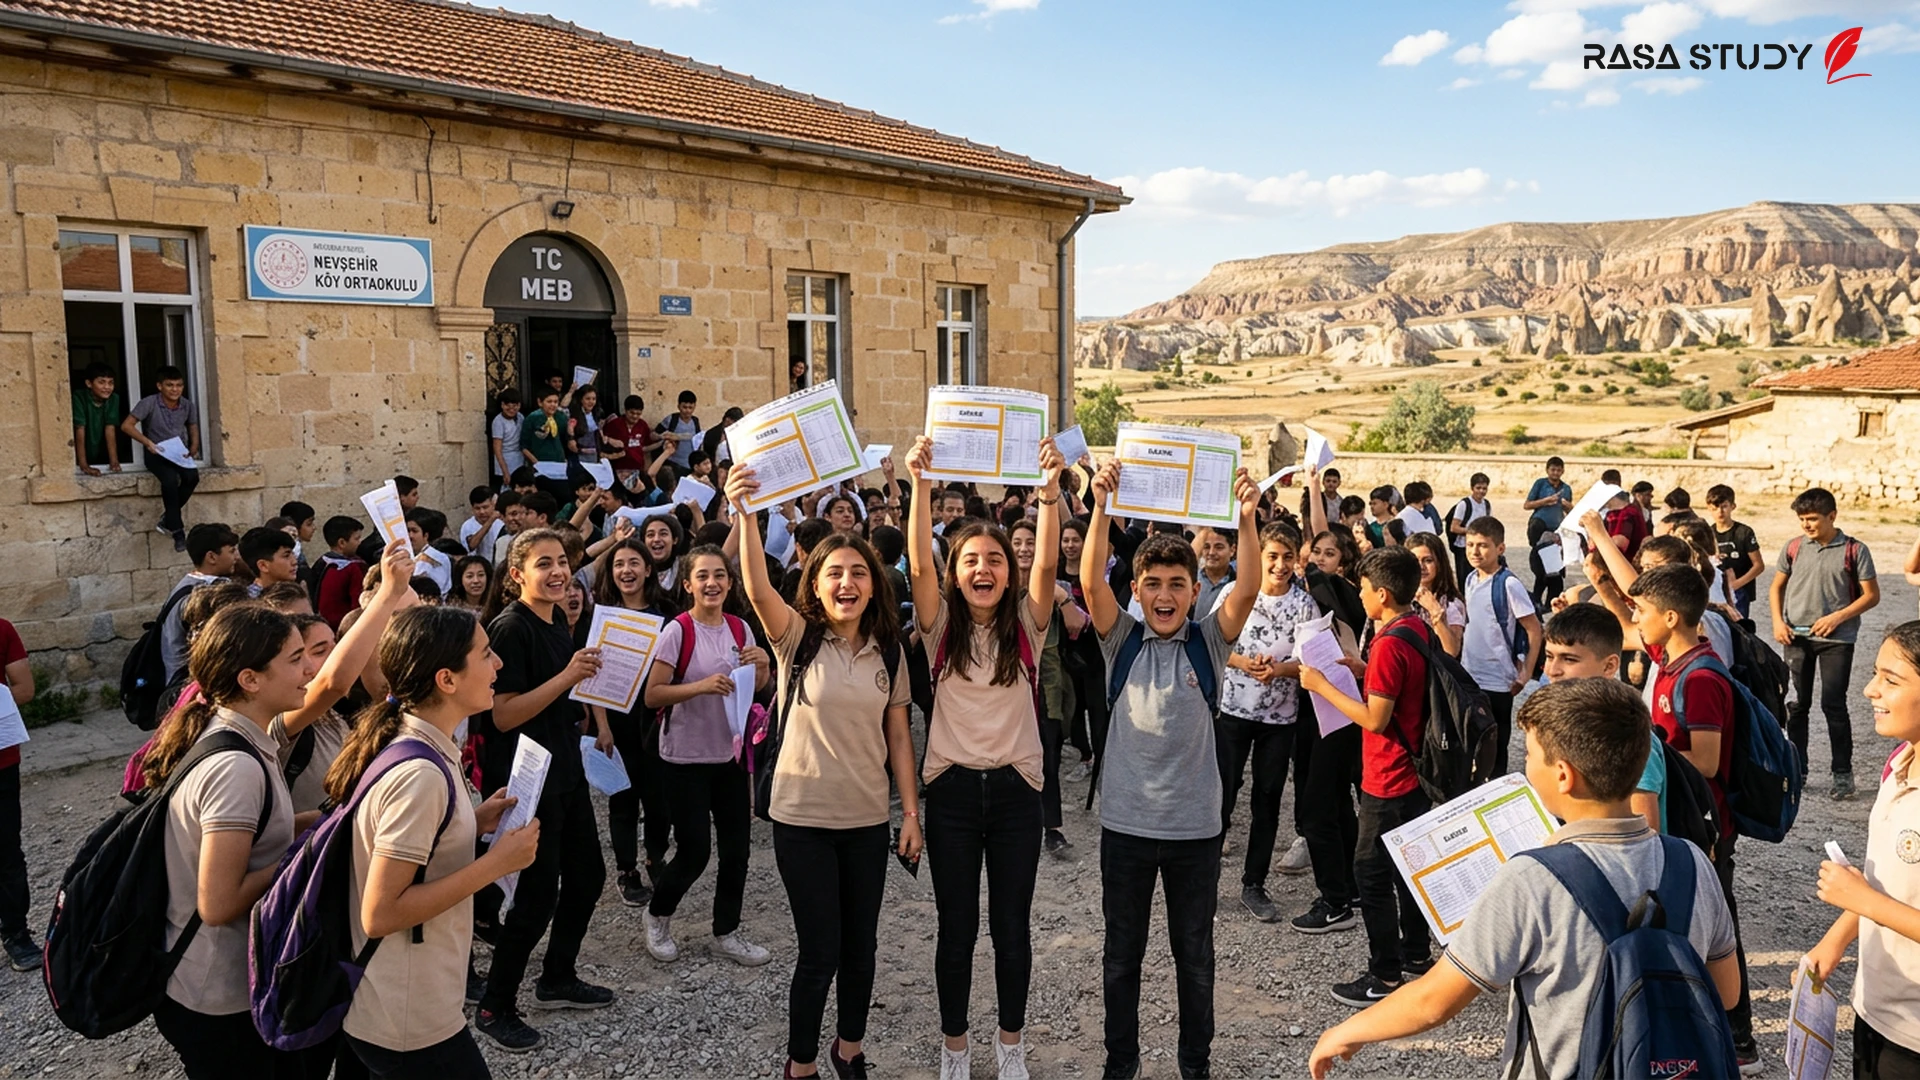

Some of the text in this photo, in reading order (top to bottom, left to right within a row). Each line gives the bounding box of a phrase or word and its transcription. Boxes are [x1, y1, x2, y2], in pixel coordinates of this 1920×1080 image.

[313, 255, 379, 273] NEVŞEHİR
[531, 247, 563, 271] TC
[315, 271, 418, 292] KÖY ORTAOKULU
[521, 277, 573, 302] MEB
